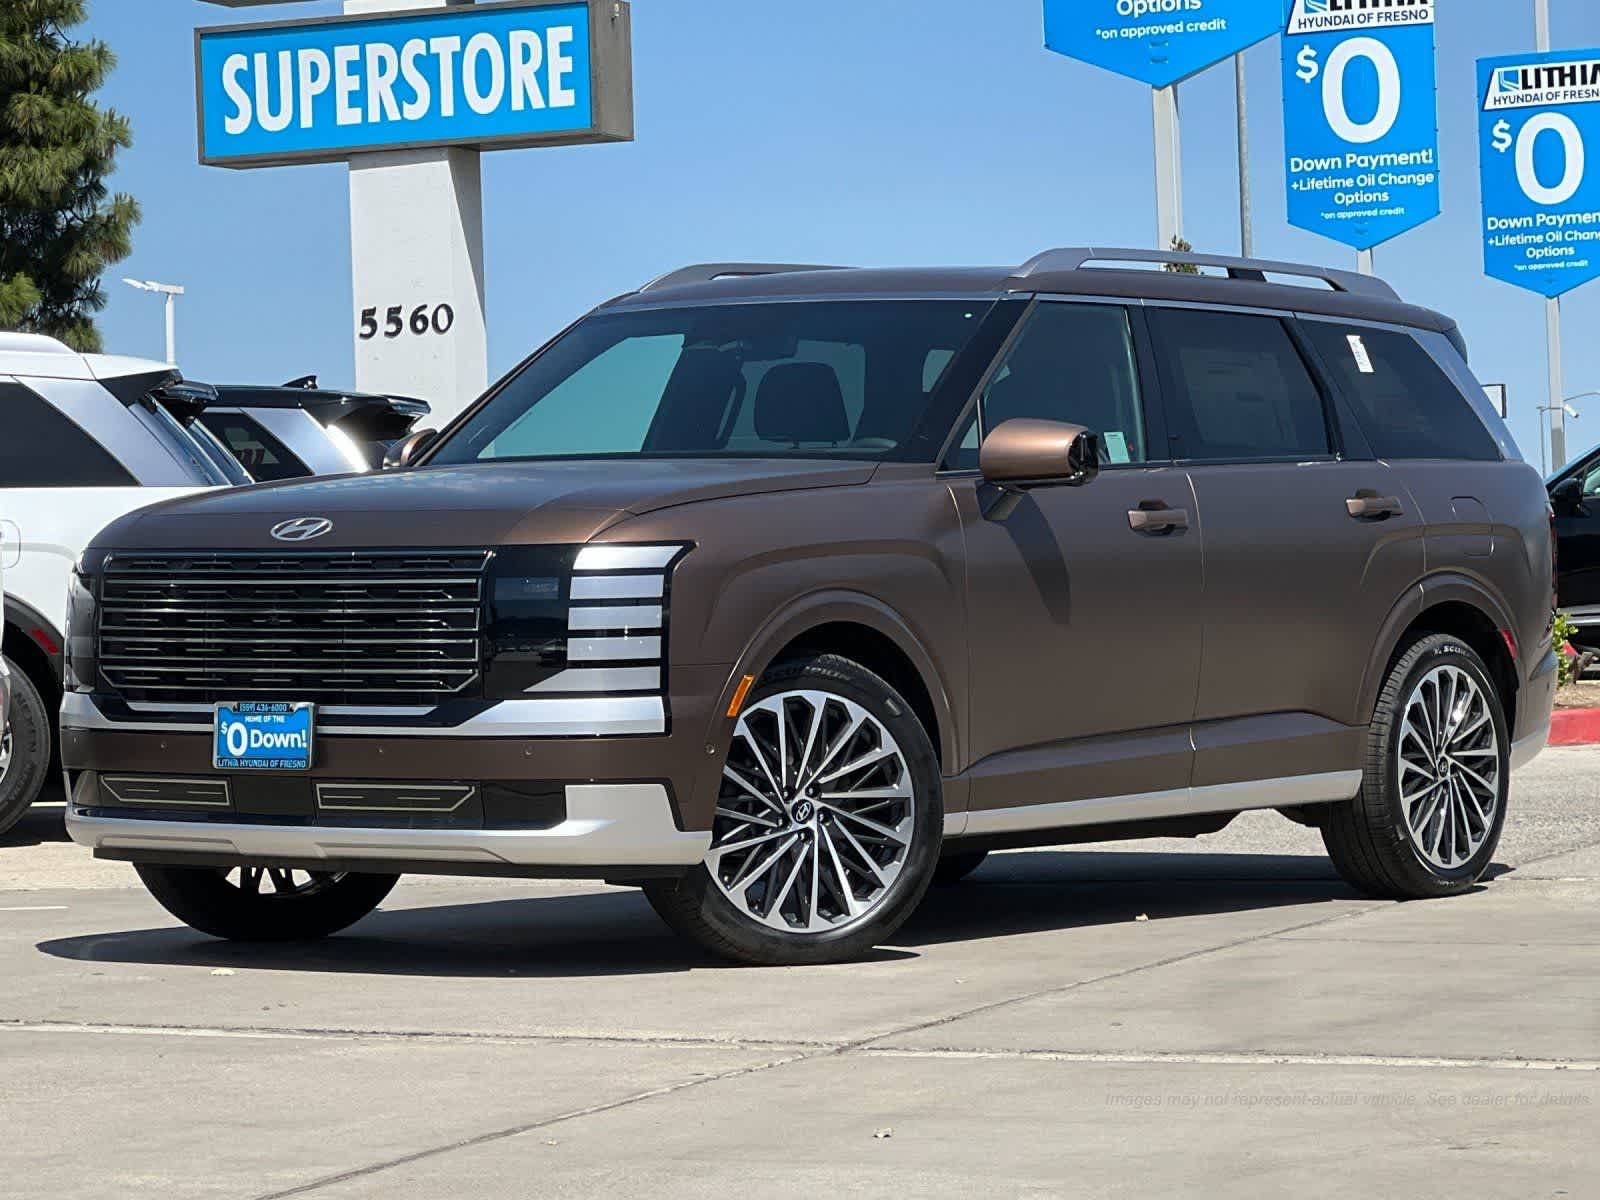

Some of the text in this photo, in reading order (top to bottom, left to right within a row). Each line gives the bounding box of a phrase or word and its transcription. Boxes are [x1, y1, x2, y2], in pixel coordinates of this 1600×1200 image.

[1298, 9, 1428, 29] HYUNDAI OF FRESNO
[1120, 20, 1184, 38] approved
[1186, 18, 1226, 32] credit
[221, 25, 576, 135] SUPERSTORE
[1493, 92, 1543, 105] HYUNDAI
[1545, 91, 1561, 101] OF
[1290, 148, 1434, 173] Down Payment!
[1291, 172, 1434, 191] +Lifetime Oil Change
[1334, 190, 1390, 206] Options
[1336, 209, 1378, 219] approved
[1379, 207, 1405, 216] credit
[1487, 216, 1533, 230] Down
[1487, 230, 1600, 246] +Lifetime Oil Chan
[1526, 246, 1575, 259] Options
[359, 303, 454, 340] 5560
[264, 715, 271, 723] OF
[273, 715, 285, 723] THE
[250, 729, 308, 748] Down!
[240, 759, 268, 768] HYUNDAI
[270, 760, 279, 768] OF
[280, 760, 306, 768] FRESNO
